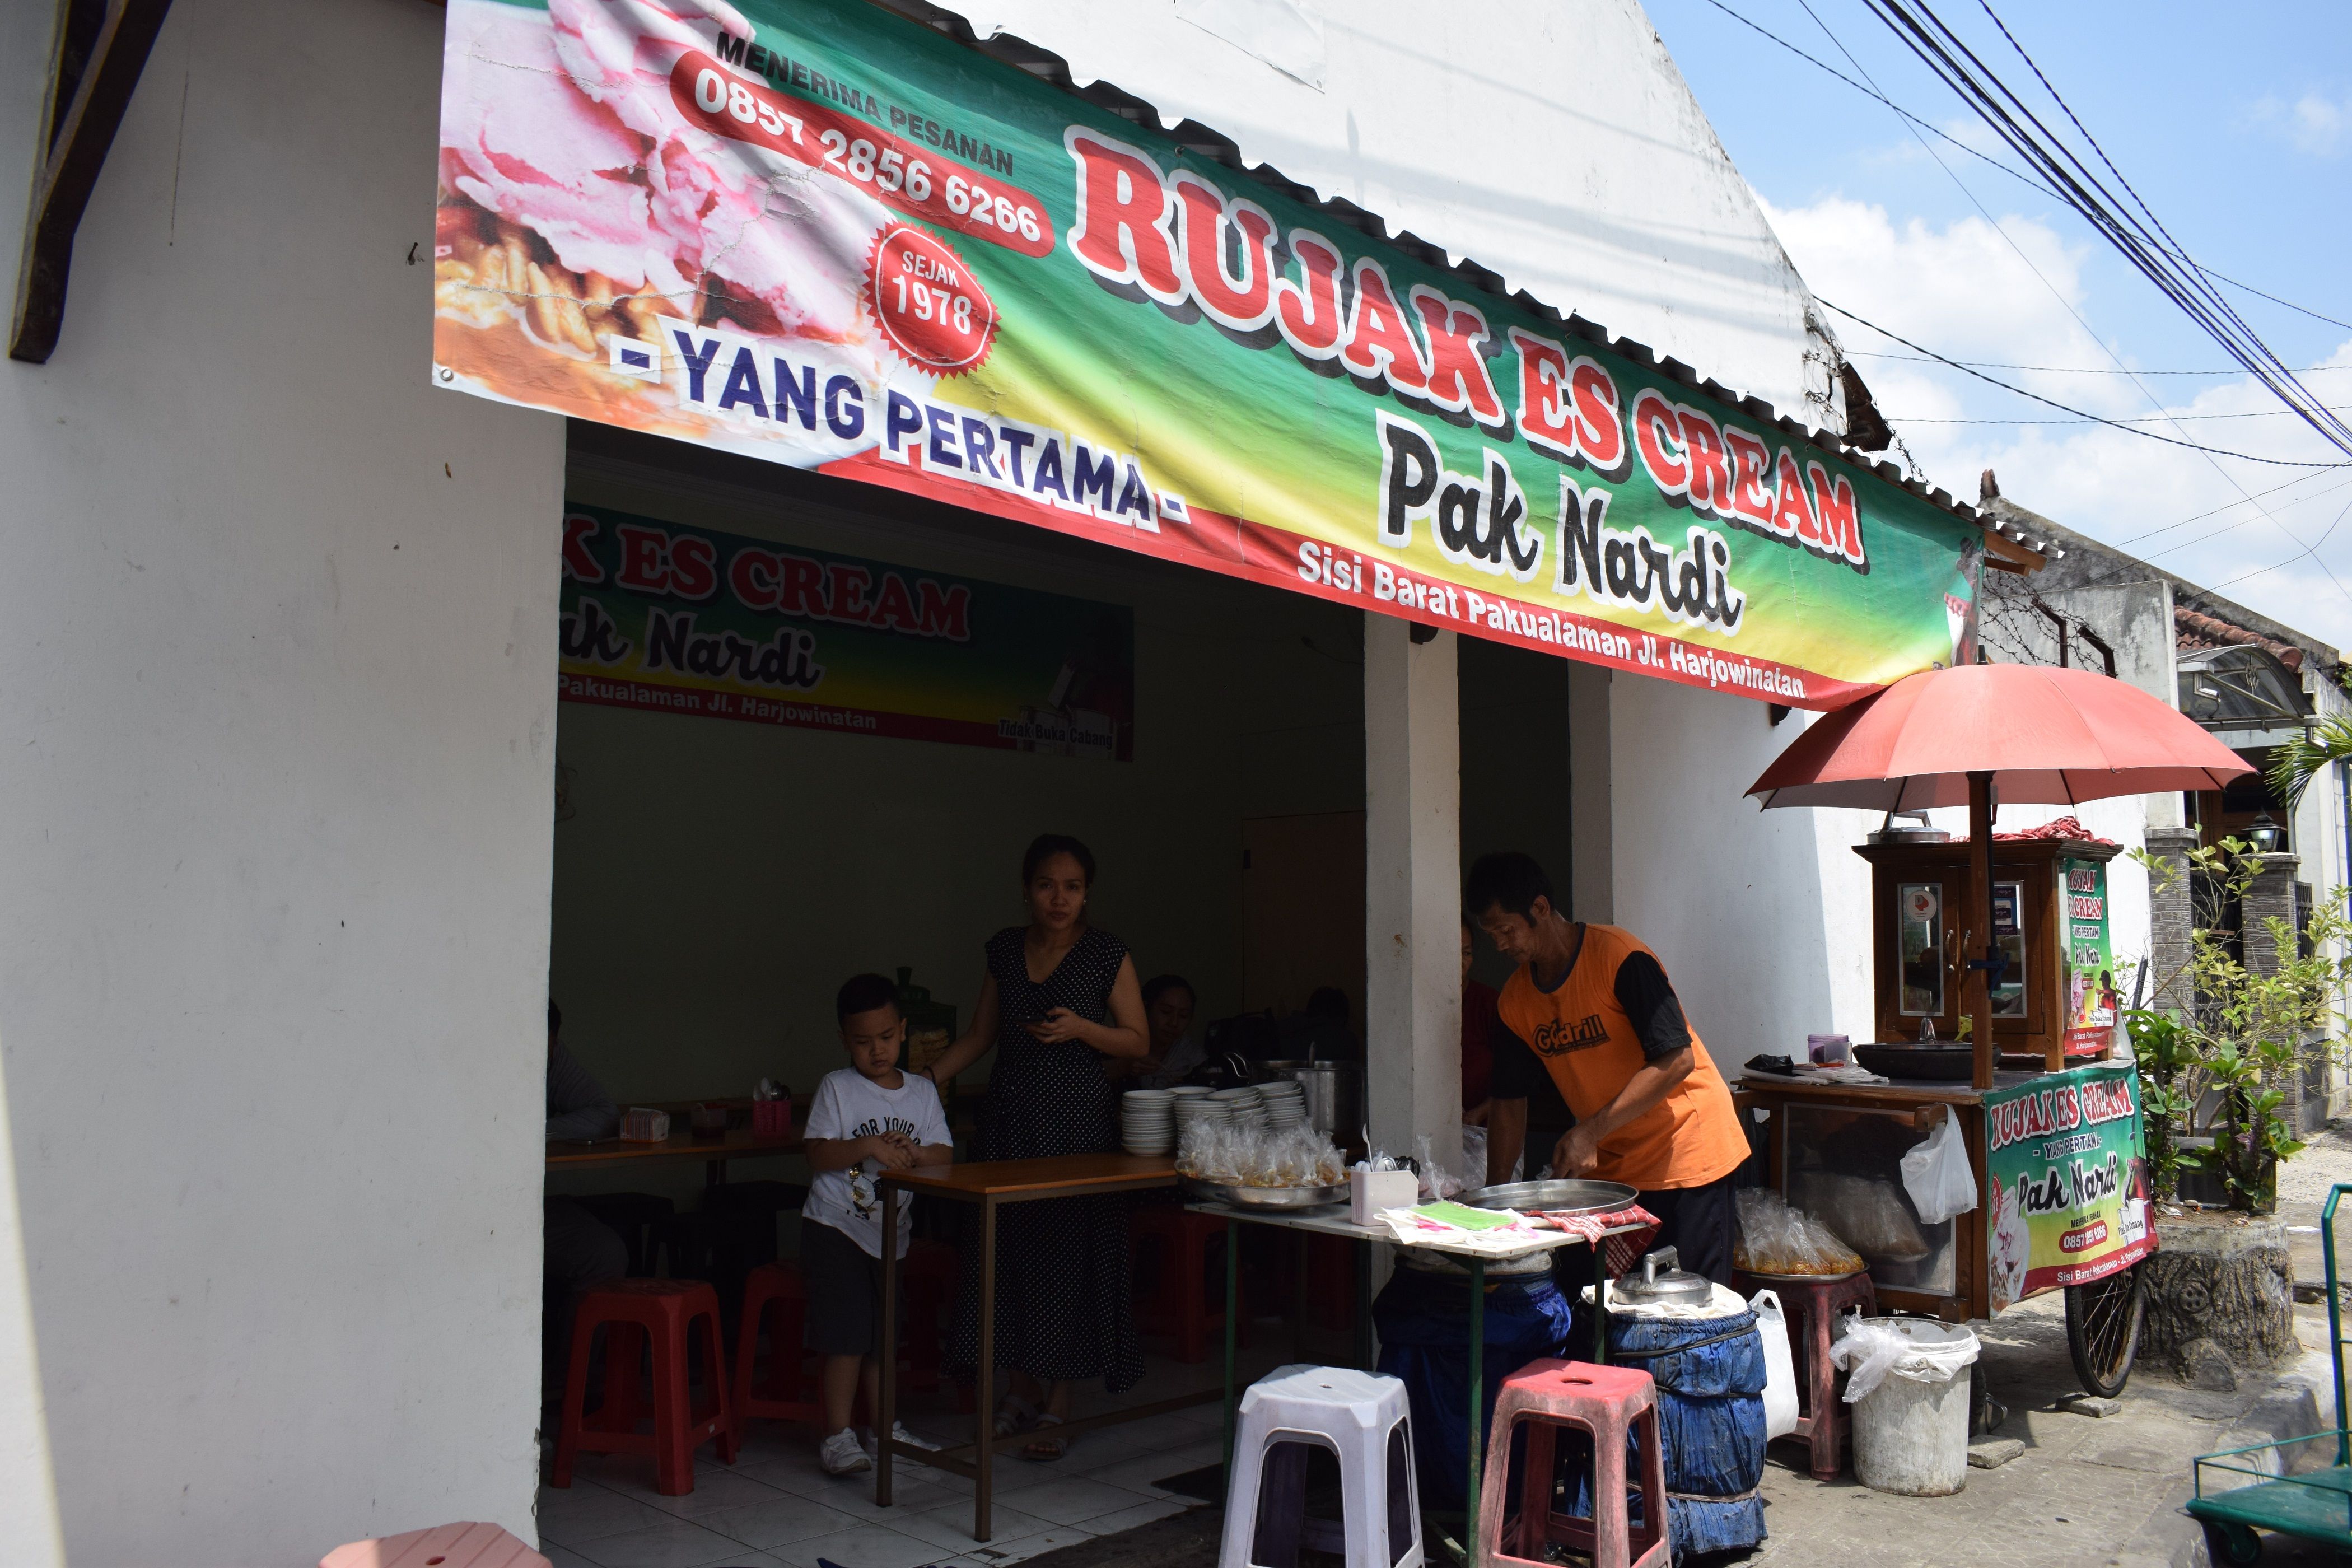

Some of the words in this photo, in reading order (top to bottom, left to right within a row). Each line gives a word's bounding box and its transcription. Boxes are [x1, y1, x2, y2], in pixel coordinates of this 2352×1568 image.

[716, 31, 882, 121] MENERIMA
[889, 104, 1014, 178] PESANAN
[695, 67, 805, 146] 0857
[820, 129, 932, 202] 2856
[945, 174, 1041, 242] 6266
[902, 249, 960, 290] SEJAK
[892, 274, 972, 337] 1978
[1068, 130, 1502, 423] RUJAK
[1511, 330, 1622, 465] ES
[1633, 393, 1863, 561] CREAM
[671, 329, 865, 441] YANG
[886, 388, 1150, 523] PERTAMA
[1383, 420, 1541, 575] Pak
[1560, 484, 1744, 629] Nardi
[618, 526, 715, 597] ES
[730, 549, 969, 638] CREAM
[647, 612, 822, 688] Nardi
[1297, 541, 1362, 594] Sisi
[1373, 561, 1460, 619] Barat
[1464, 590, 1632, 661] Pakualaman
[1637, 634, 1665, 669] Jl.
[1669, 641, 1807, 699] Harjowinatan
[558, 676, 701, 709] Pakualaman
[707, 693, 734, 713] Jl.
[740, 696, 878, 730] Harjowinatan
[999, 719, 1032, 738] Tidak
[1035, 723, 1066, 741] Buka
[1069, 727, 1113, 750] Cabang
[1991, 1094, 2055, 1148] RUJAK
[2056, 1088, 2079, 1127] ES
[2082, 1080, 2134, 1122] CREAM
[2045, 1138, 2064, 1159] YANG
[2018, 1170, 2069, 1218] Pak
[2071, 1154, 2117, 1206] Nardi
[2057, 1270, 2073, 1282] Sisi
[2075, 1268, 2092, 1280] Barat
[2093, 1259, 2118, 1276] Pakualaman
[2064, 1234, 2084, 1248] 0857
